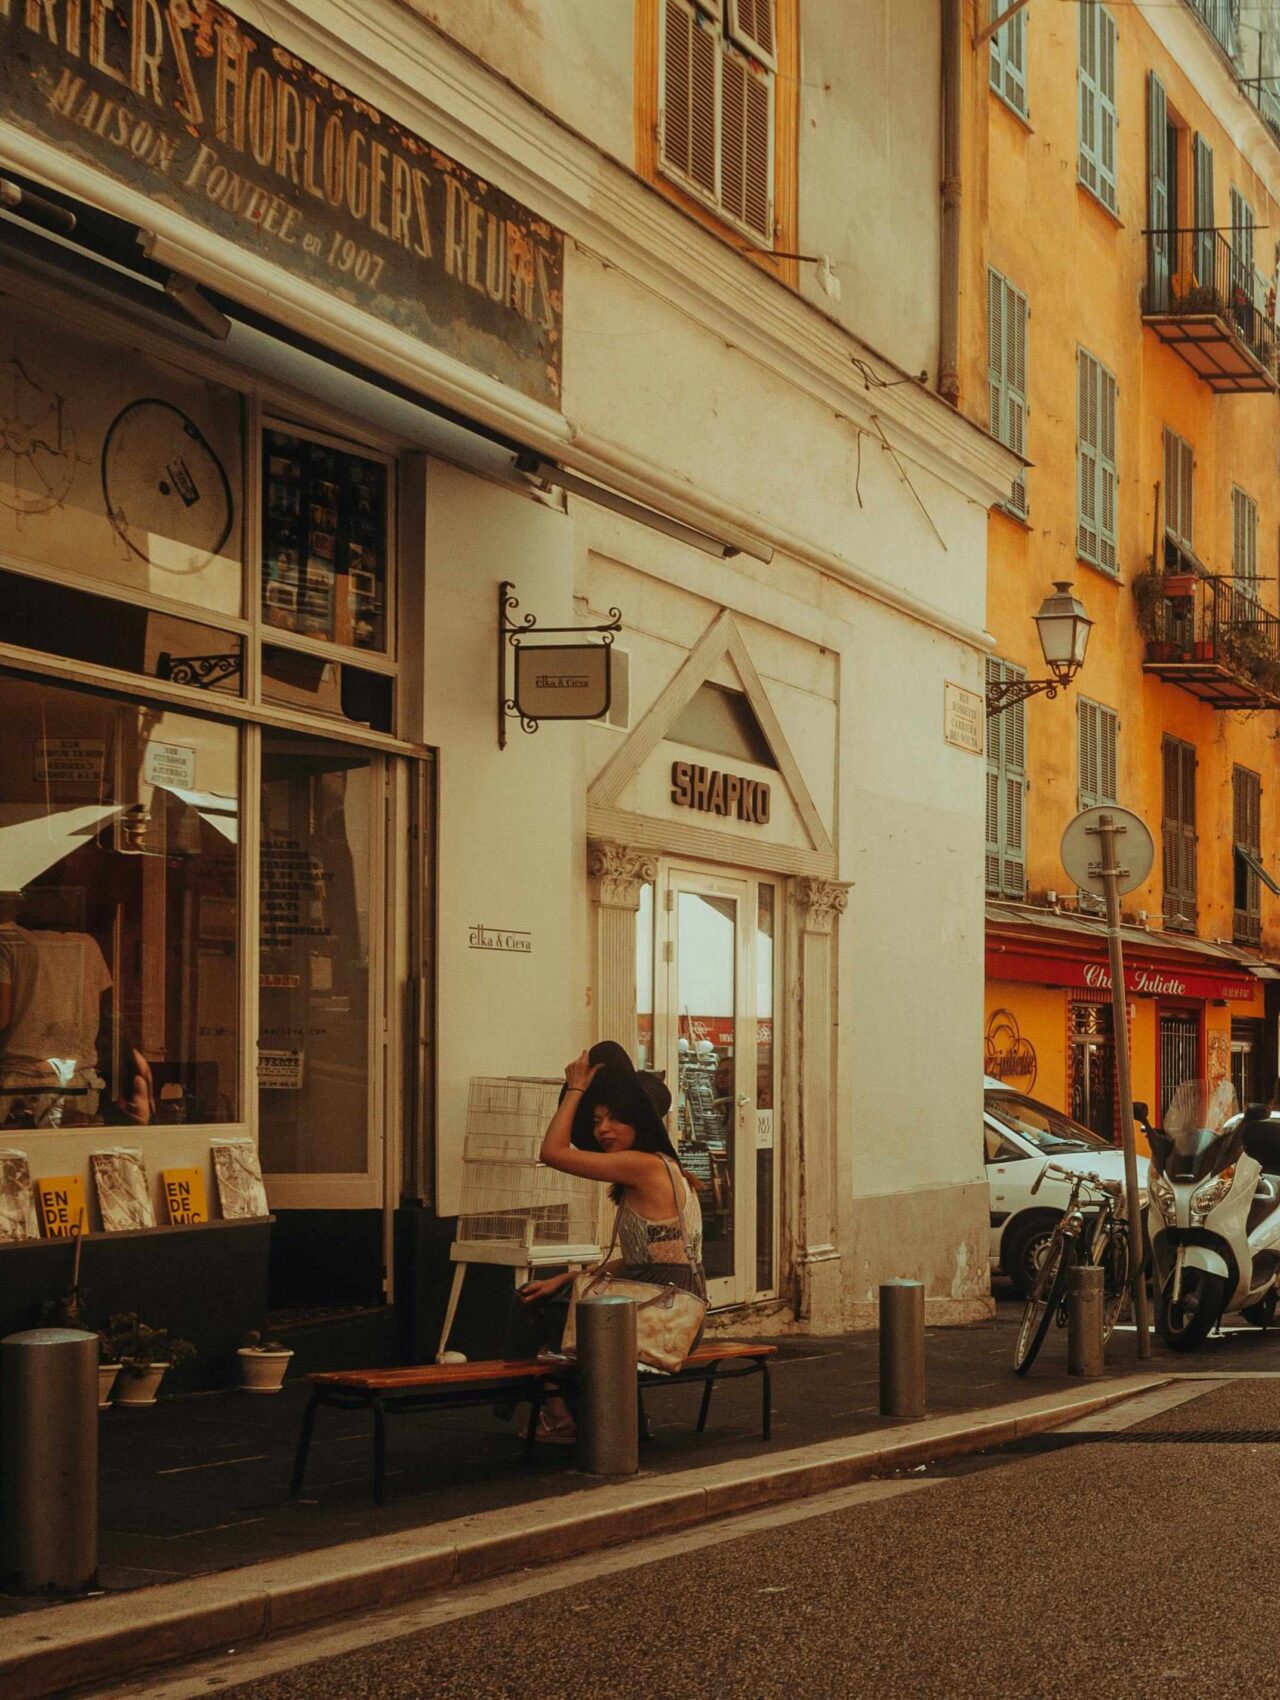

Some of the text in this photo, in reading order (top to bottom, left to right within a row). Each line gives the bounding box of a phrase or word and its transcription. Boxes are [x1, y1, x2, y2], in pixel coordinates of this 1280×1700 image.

[215, 24, 432, 259] HORLOGERS
[51, 67, 178, 174] MAISON
[303, 233, 322, 256] en
[328, 231, 384, 288] 1907
[671, 761, 770, 824] SHAPKO
[496, 933, 503, 948] &
[1130, 970, 1186, 995] Juliette
[167, 1181, 191, 1197] EN
[42, 1191, 68, 1208] EN
[169, 1199, 191, 1214] DE
[45, 1209, 67, 1225] DE
